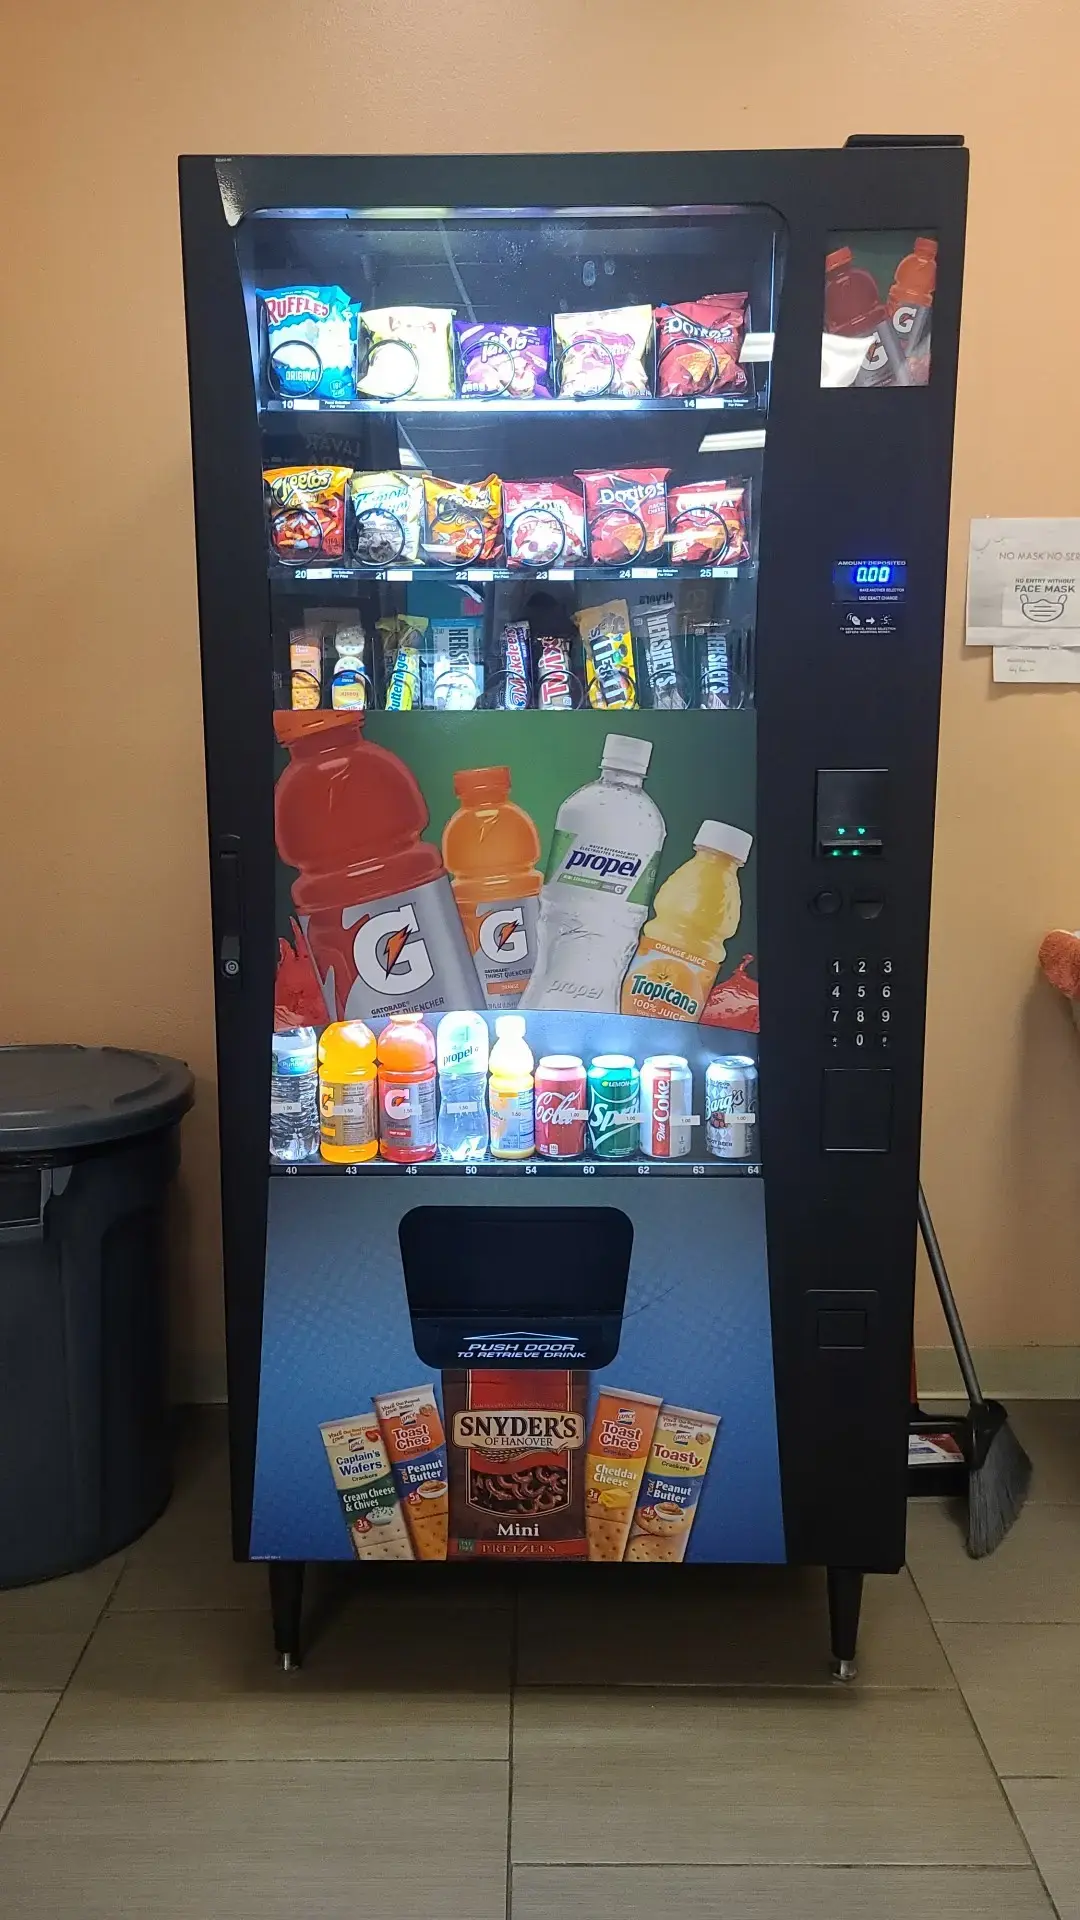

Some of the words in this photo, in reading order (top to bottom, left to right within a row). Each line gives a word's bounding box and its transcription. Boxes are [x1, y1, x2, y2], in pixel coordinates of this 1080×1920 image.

[265, 296, 329, 324] RUFFLES
[893, 307, 917, 333] G
[282, 401, 293, 409] 10
[600, 482, 665, 503] Doritos
[999, 552, 1015, 560] NO
[1017, 552, 1045, 560] MASK
[1047, 552, 1063, 560] NO
[295, 570, 306, 579] 20
[376, 572, 386, 580] 21
[456, 571, 467, 580] 22
[536, 571, 548, 580] 23
[619, 570, 631, 578] 24
[700, 569, 711, 578] 25
[1014, 584, 1041, 593] FACE
[1044, 584, 1076, 593] MASK
[647, 615, 677, 687] HERSHEY'S
[565, 850, 642, 877] propel
[479, 907, 528, 963] G
[353, 903, 435, 995] G
[655, 942, 685, 959] ORANGE
[685, 951, 707, 967] JUICE
[833, 961, 839, 973] 1
[858, 961, 866, 973] 2
[883, 961, 892, 973] 3
[631, 974, 698, 1015] Tropicana
[832, 986, 840, 998] 4
[857, 986, 866, 998] 5
[882, 986, 891, 998] 6
[371, 1001, 406, 1015] GATORADE
[403, 997, 445, 1014] QUENCHER
[633, 998, 657, 1013] 100%
[658, 1008, 686, 1021] JUICE
[832, 1010, 839, 1022] 7
[857, 1010, 865, 1022] 8
[881, 1010, 890, 1022] 9
[856, 1034, 864, 1046] 0
[444, 1046, 473, 1066] propel
[654, 1080, 670, 1122] Coke
[286, 1166, 297, 1174] 40
[346, 1166, 357, 1174] 43
[406, 1166, 417, 1174] 45
[466, 1166, 477, 1174] 50
[525, 1166, 537, 1174] 54
[583, 1166, 595, 1174] 60
[637, 1166, 650, 1174] 62
[693, 1166, 705, 1174] 63
[748, 1166, 759, 1174] 64
[468, 1343, 520, 1351] PUSH
[524, 1343, 575, 1351] DOOR
[392, 1425, 428, 1439] Toast
[460, 1416, 579, 1439] SNYDER'S
[604, 1421, 641, 1441] Toast
[396, 1436, 430, 1449] Chee
[485, 1437, 500, 1445] OF
[501, 1437, 553, 1446] HANOVER
[600, 1433, 638, 1450] Chee
[336, 1450, 380, 1465] Captain's
[653, 1443, 703, 1467] Toasty
[339, 1461, 383, 1476] Wafers
[407, 1459, 443, 1473] Peanut
[595, 1464, 637, 1480] Cheddar
[662, 1461, 690, 1471] Crackers
[351, 1473, 378, 1482] Crackers
[409, 1470, 442, 1483] Butter
[594, 1473, 629, 1487] Cheese
[343, 1491, 368, 1503] Cream
[369, 1486, 396, 1498] Cheese
[587, 1489, 598, 1499] 3g
[655, 1480, 692, 1496] Peanut
[653, 1489, 686, 1504] Butter
[345, 1503, 353, 1512] &
[354, 1499, 379, 1510] Chives
[497, 1523, 540, 1537] Mini
[482, 1544, 555, 1553] PRETZELS
